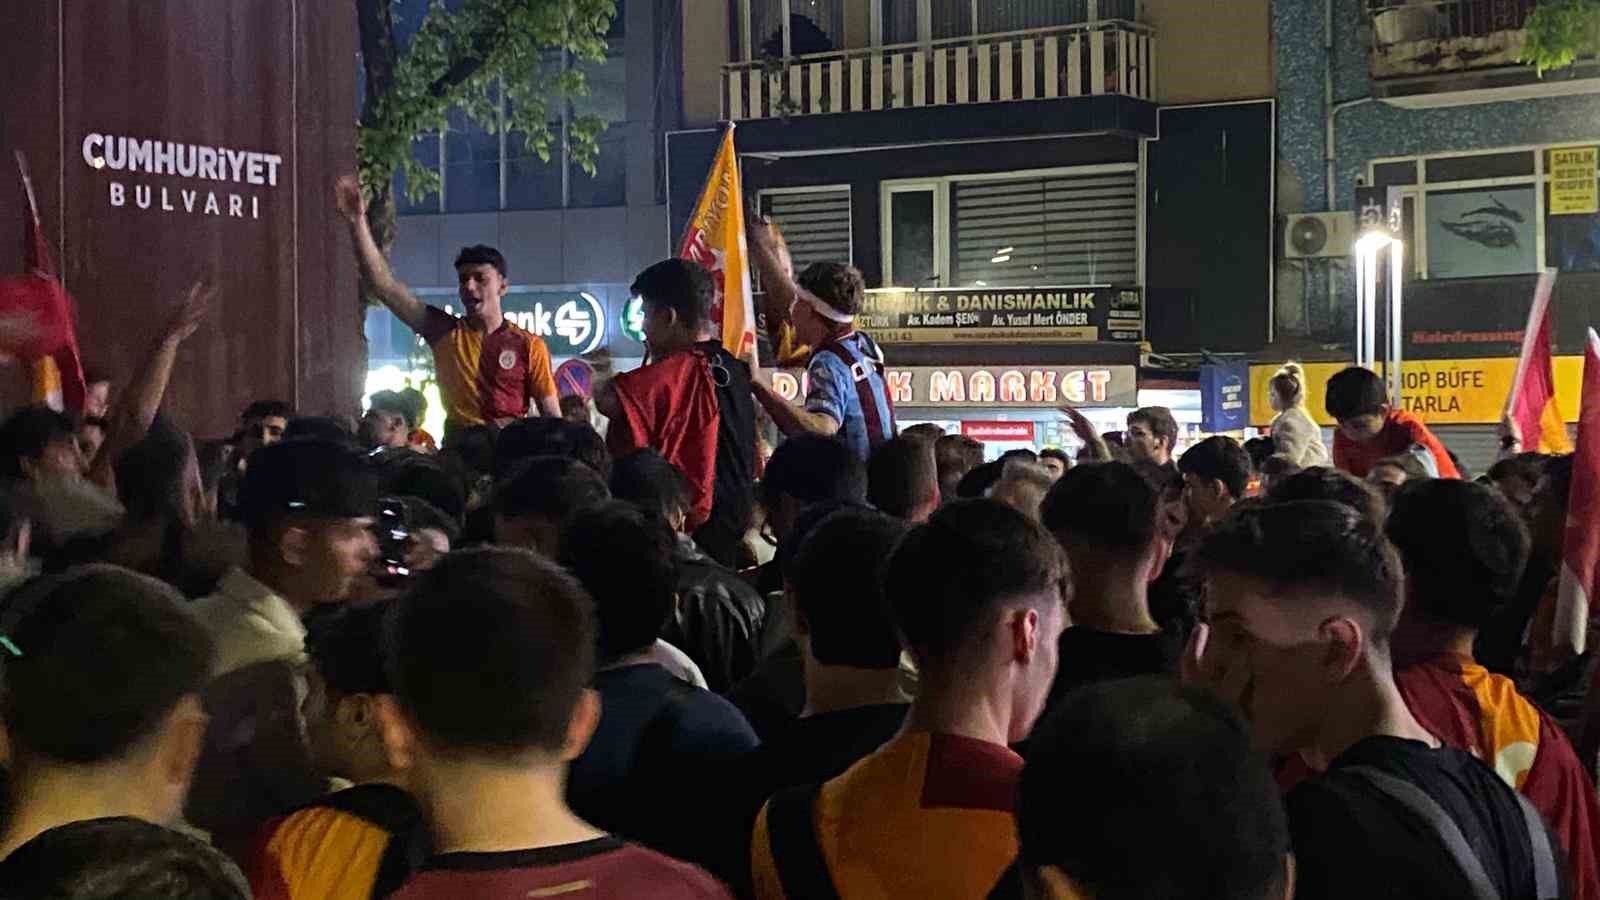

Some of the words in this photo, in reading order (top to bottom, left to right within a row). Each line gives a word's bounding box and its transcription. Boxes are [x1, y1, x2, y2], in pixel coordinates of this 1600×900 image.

[110, 183, 259, 220] BULVARI
[936, 295, 951, 311] &
[956, 293, 1096, 311] DANISMANLIK
[1055, 310, 1088, 325] ÖNDER
[929, 370, 1112, 402] MARKET
[1435, 366, 1484, 389] BÜFE
